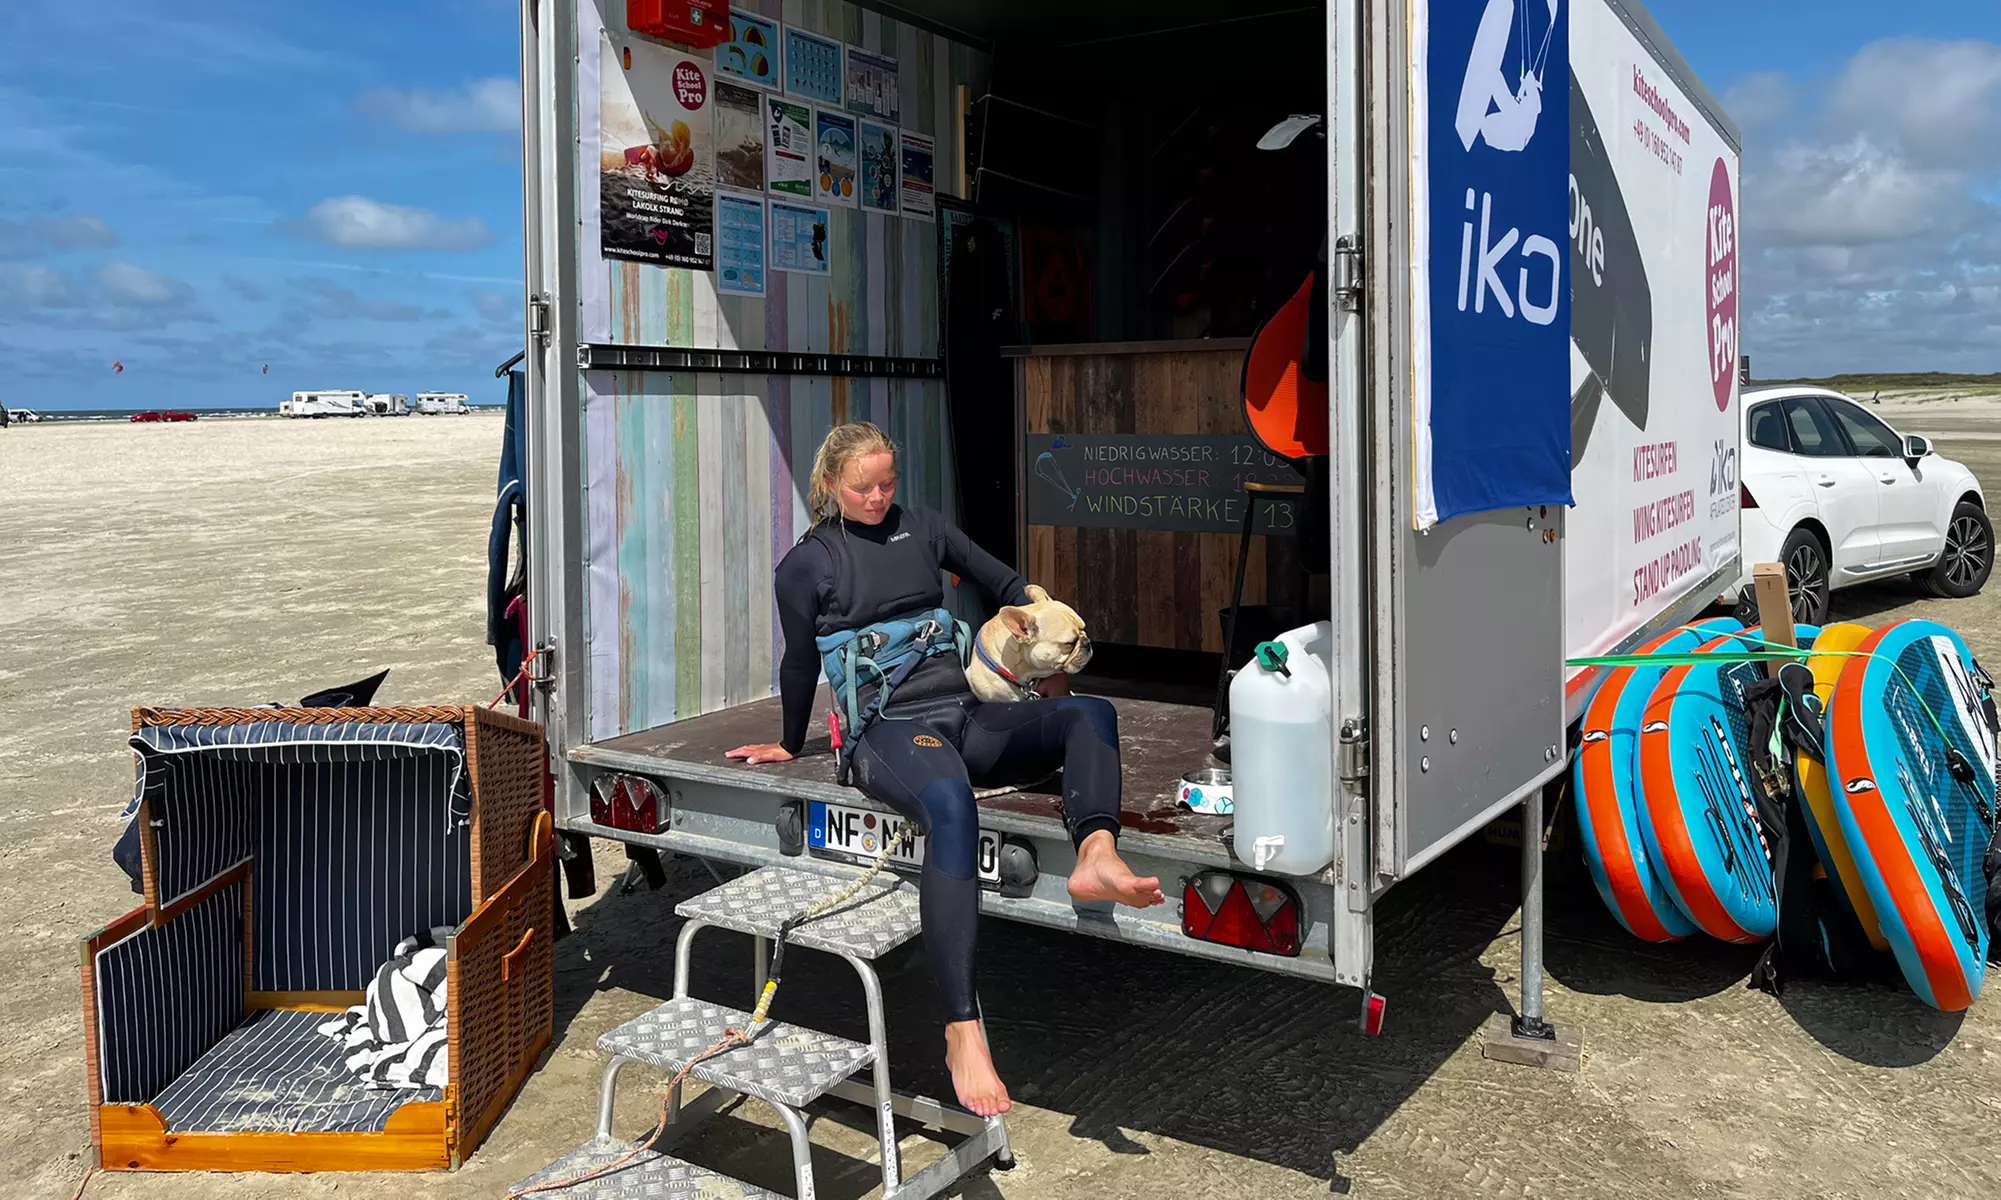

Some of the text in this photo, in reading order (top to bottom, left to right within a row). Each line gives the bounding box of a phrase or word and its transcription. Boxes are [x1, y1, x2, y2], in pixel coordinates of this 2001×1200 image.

[676, 68, 700, 80] Kite
[677, 81, 701, 89] School
[678, 89, 703, 103] Pro
[1633, 64, 1690, 145] kiteschoolpro.com
[627, 188, 669, 203] KITESURFING
[632, 201, 684, 216] LAKOLK STRAND
[603, 247, 660, 258] www.kiteschoolpro.com
[1709, 203, 1733, 267] Kite
[1457, 187, 1561, 326] iko
[1711, 260, 1733, 310] School
[1712, 313, 1734, 382] Pro
[1633, 440, 1677, 483] KITESURFEN
[1264, 503, 1294, 528] 13
[1633, 503, 1656, 544] WING
[1657, 488, 1695, 535] KITESURFEN
[1634, 558, 1660, 607] STAND
[1660, 548, 1670, 590] UP
[1671, 535, 1702, 585] PADDLING
[1713, 719, 1772, 862] urfstar
[814, 828, 821, 839] D
[827, 809, 860, 847] NF
